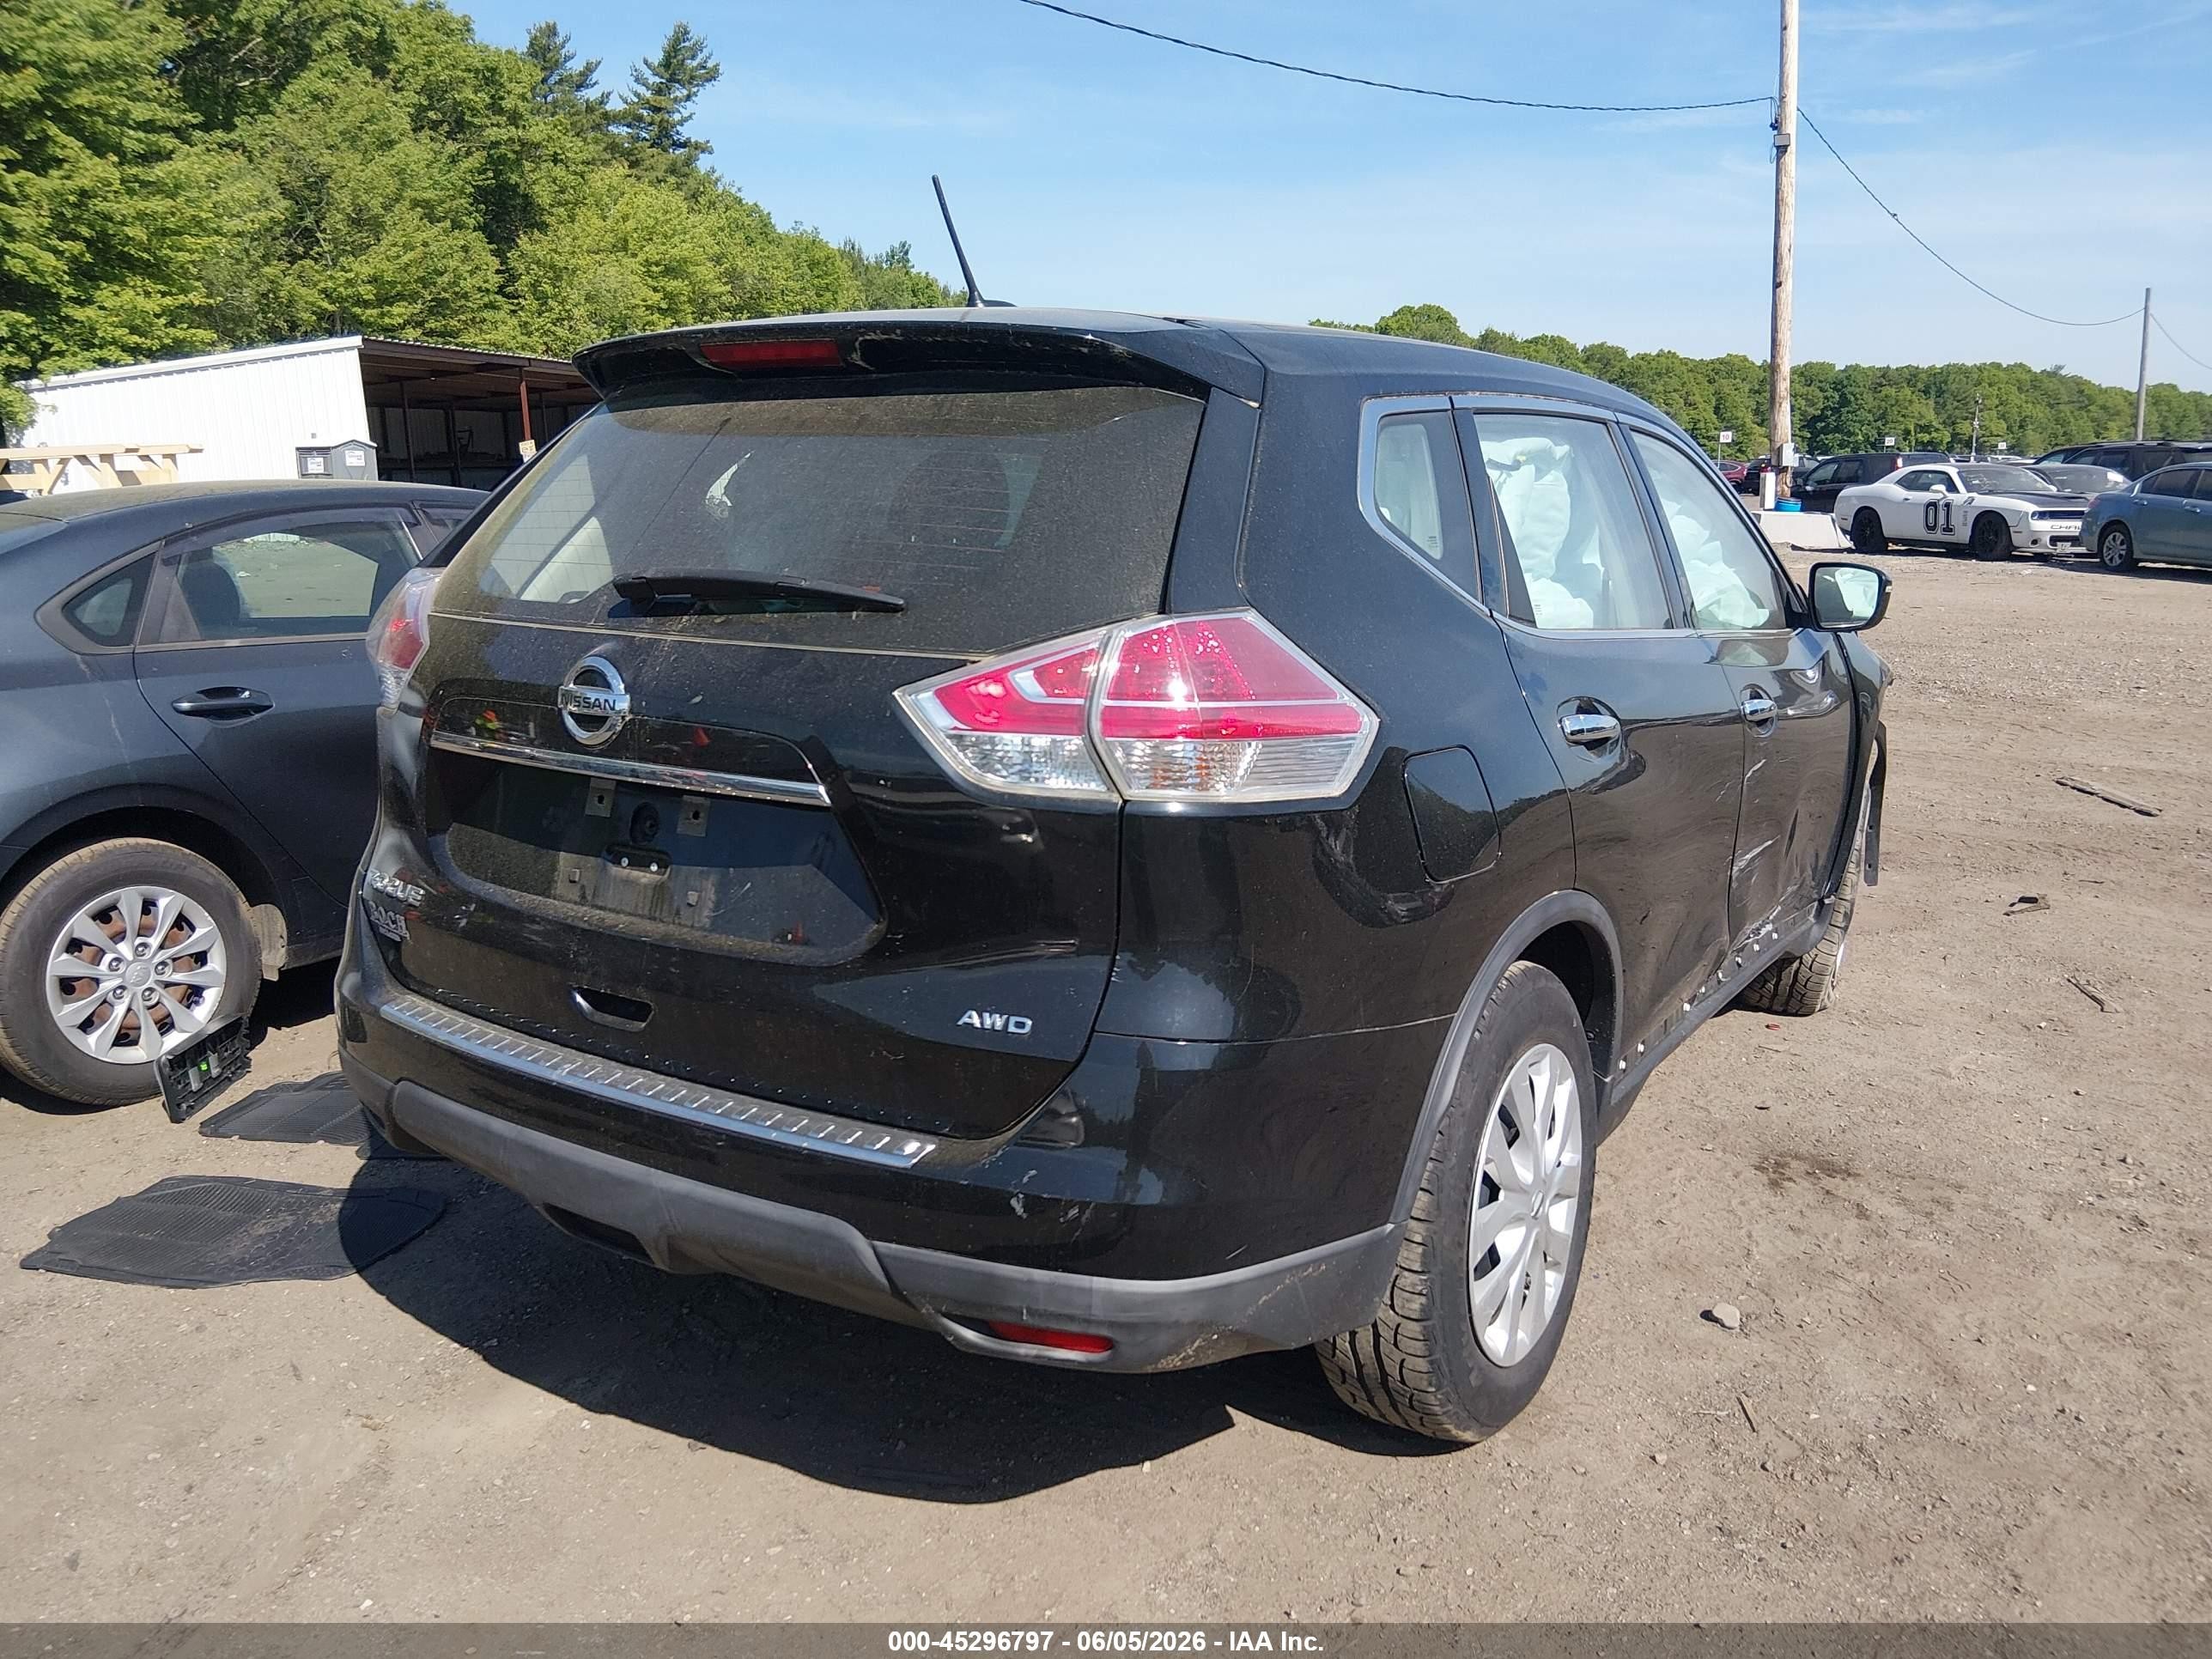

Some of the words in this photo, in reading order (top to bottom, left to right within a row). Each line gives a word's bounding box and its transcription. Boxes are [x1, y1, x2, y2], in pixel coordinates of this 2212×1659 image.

[1923, 499, 1955, 536] 01
[561, 691, 617, 711] NISSAN
[956, 1009, 1033, 1034] AWD
